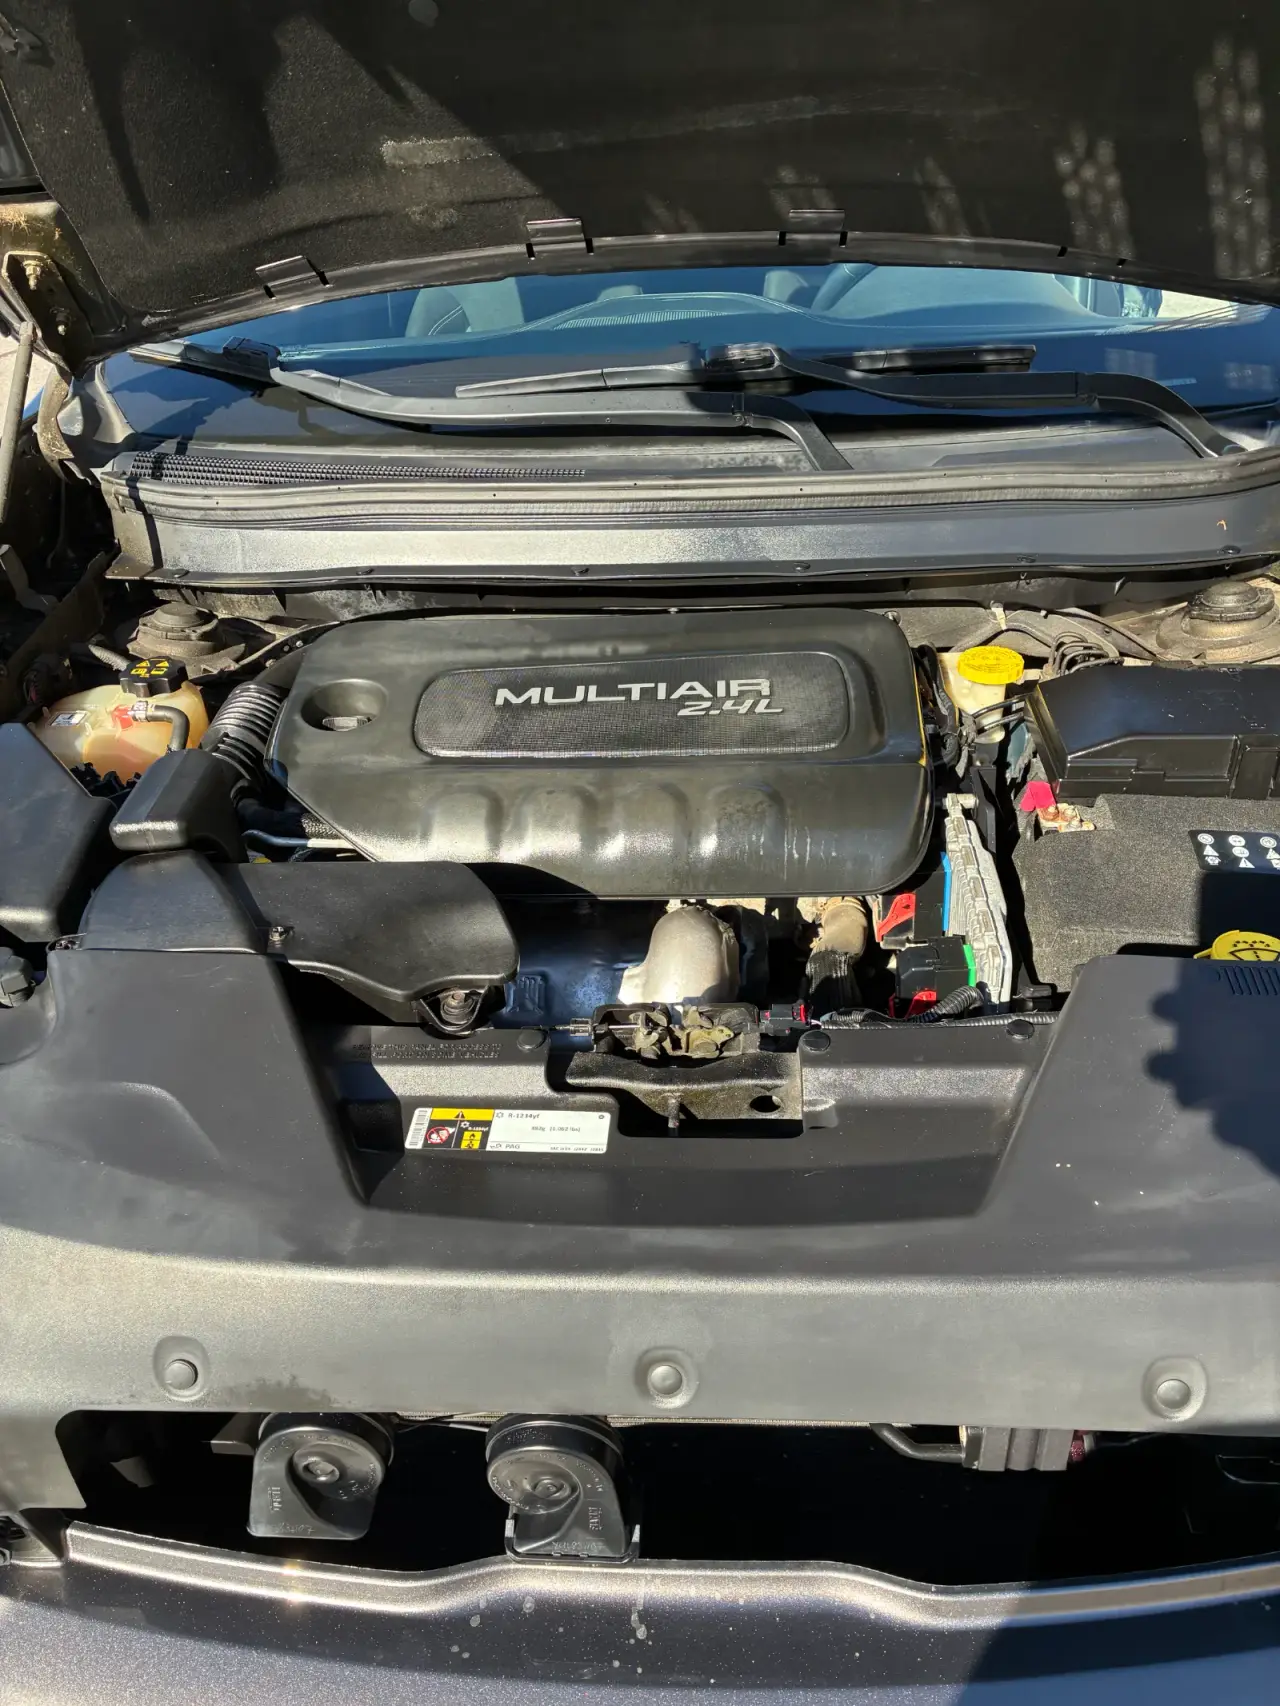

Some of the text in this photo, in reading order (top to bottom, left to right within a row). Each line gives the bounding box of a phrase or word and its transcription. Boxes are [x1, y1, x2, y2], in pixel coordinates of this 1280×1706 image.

[495, 678, 771, 706] MULTIAIR
[677, 698, 783, 716] 2.4L
[508, 1112, 540, 1120] R-1234yf
